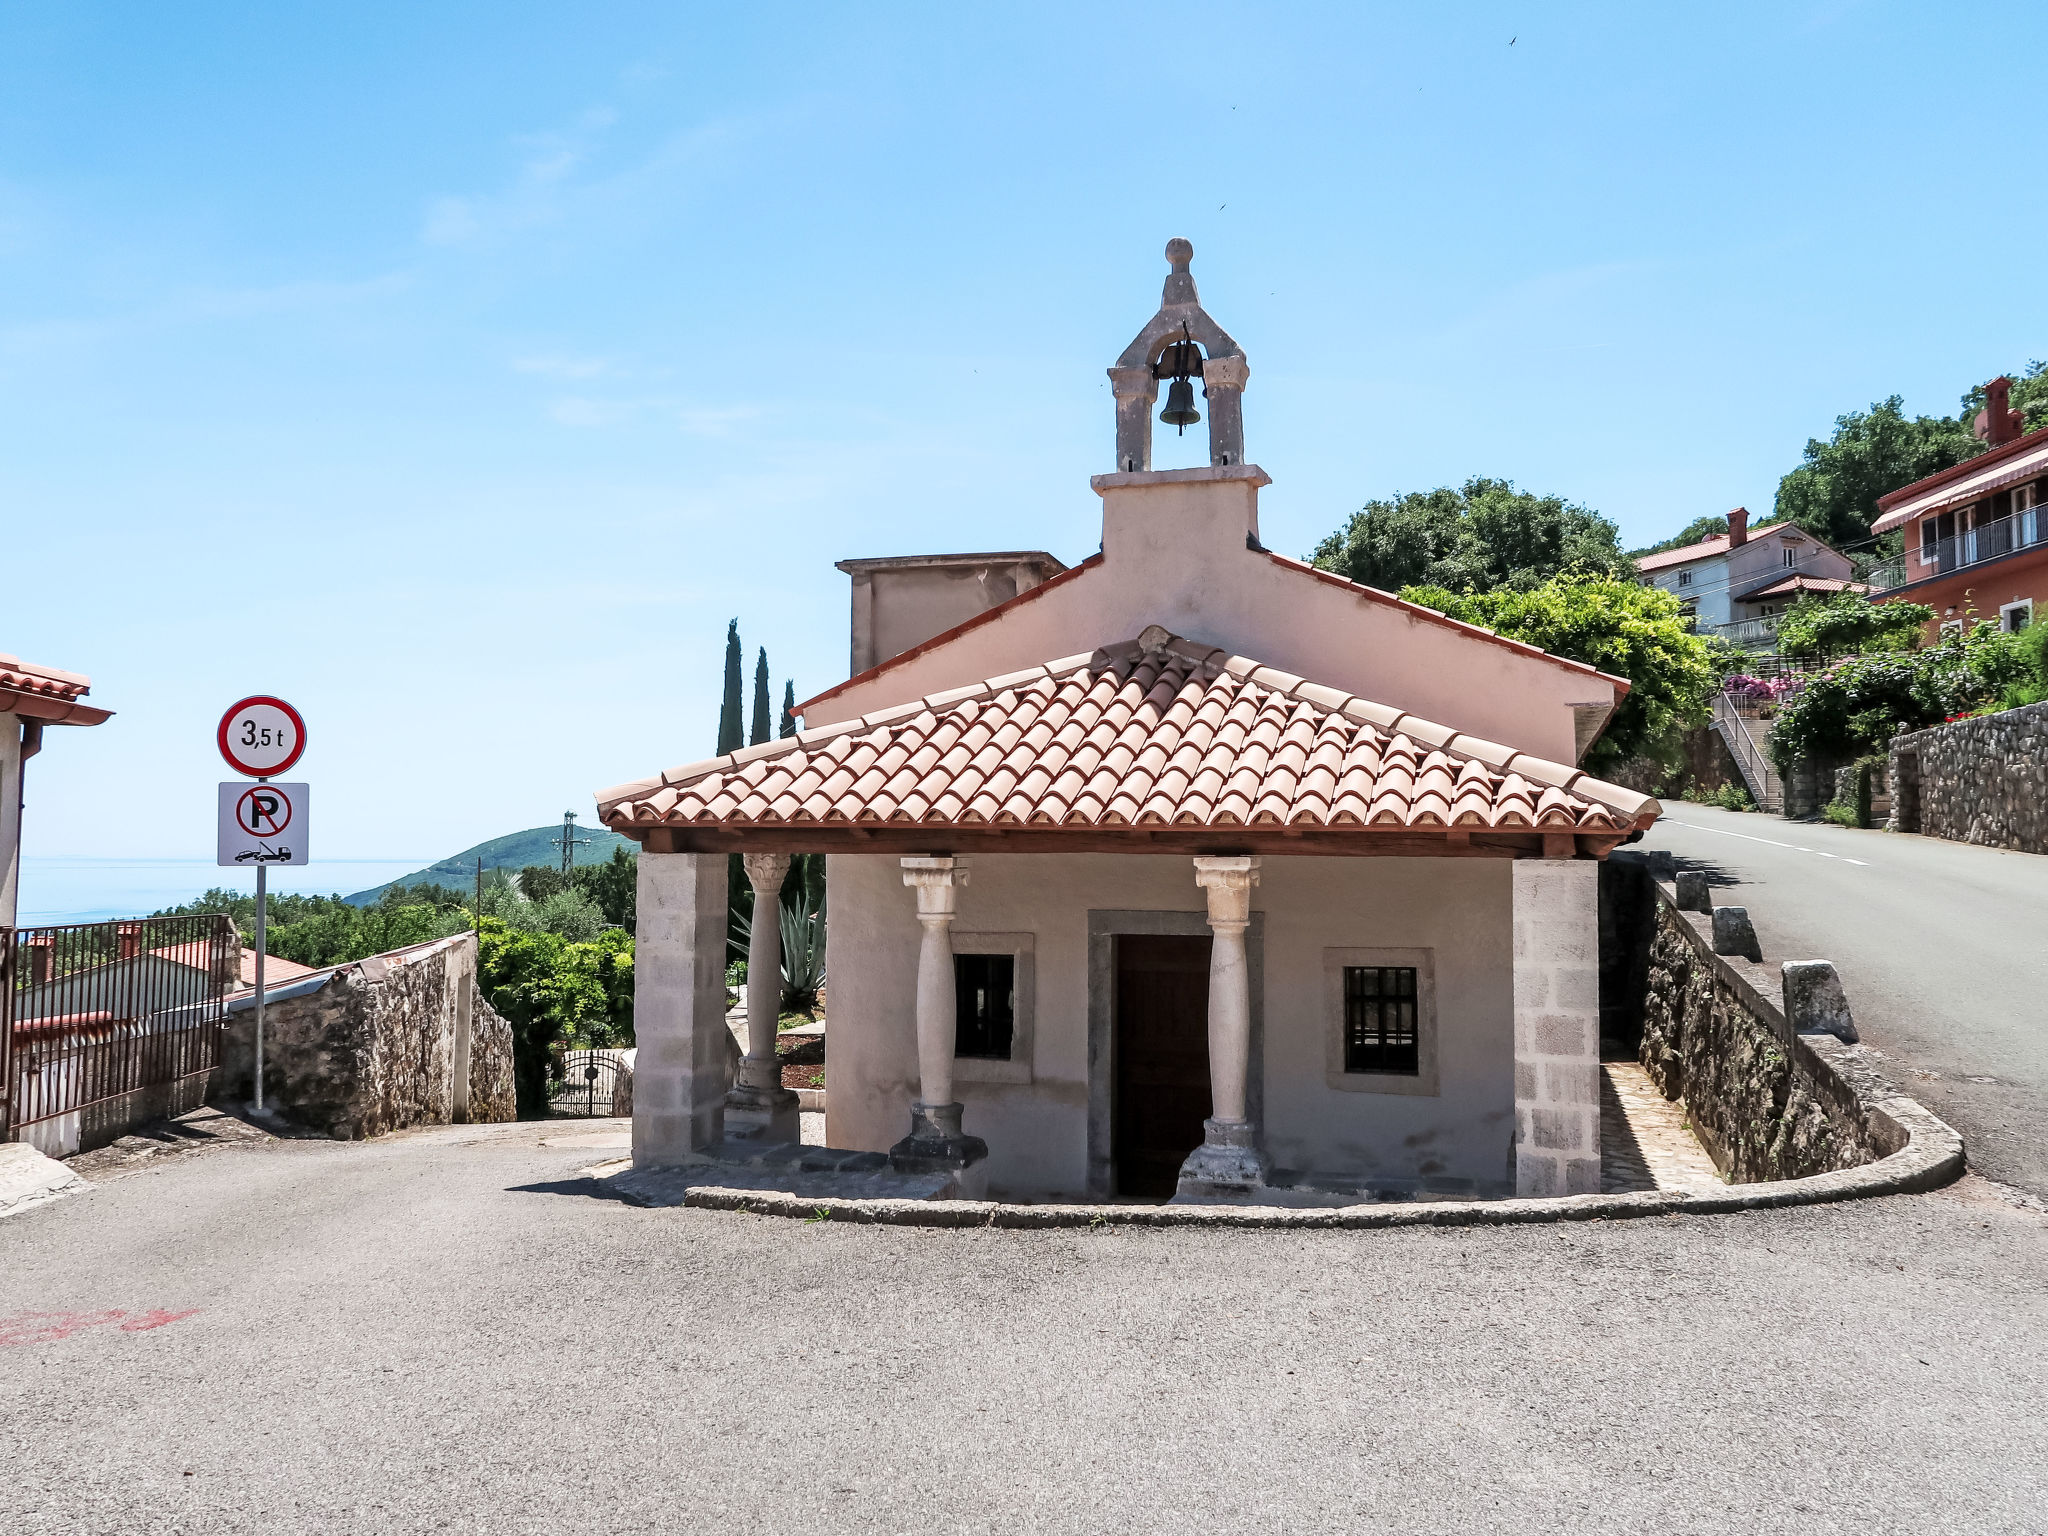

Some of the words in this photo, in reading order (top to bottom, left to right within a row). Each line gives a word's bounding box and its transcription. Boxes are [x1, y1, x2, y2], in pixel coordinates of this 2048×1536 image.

[241, 719, 271, 749] 3,5
[276, 729, 284, 747] t
[251, 795, 279, 828] P
